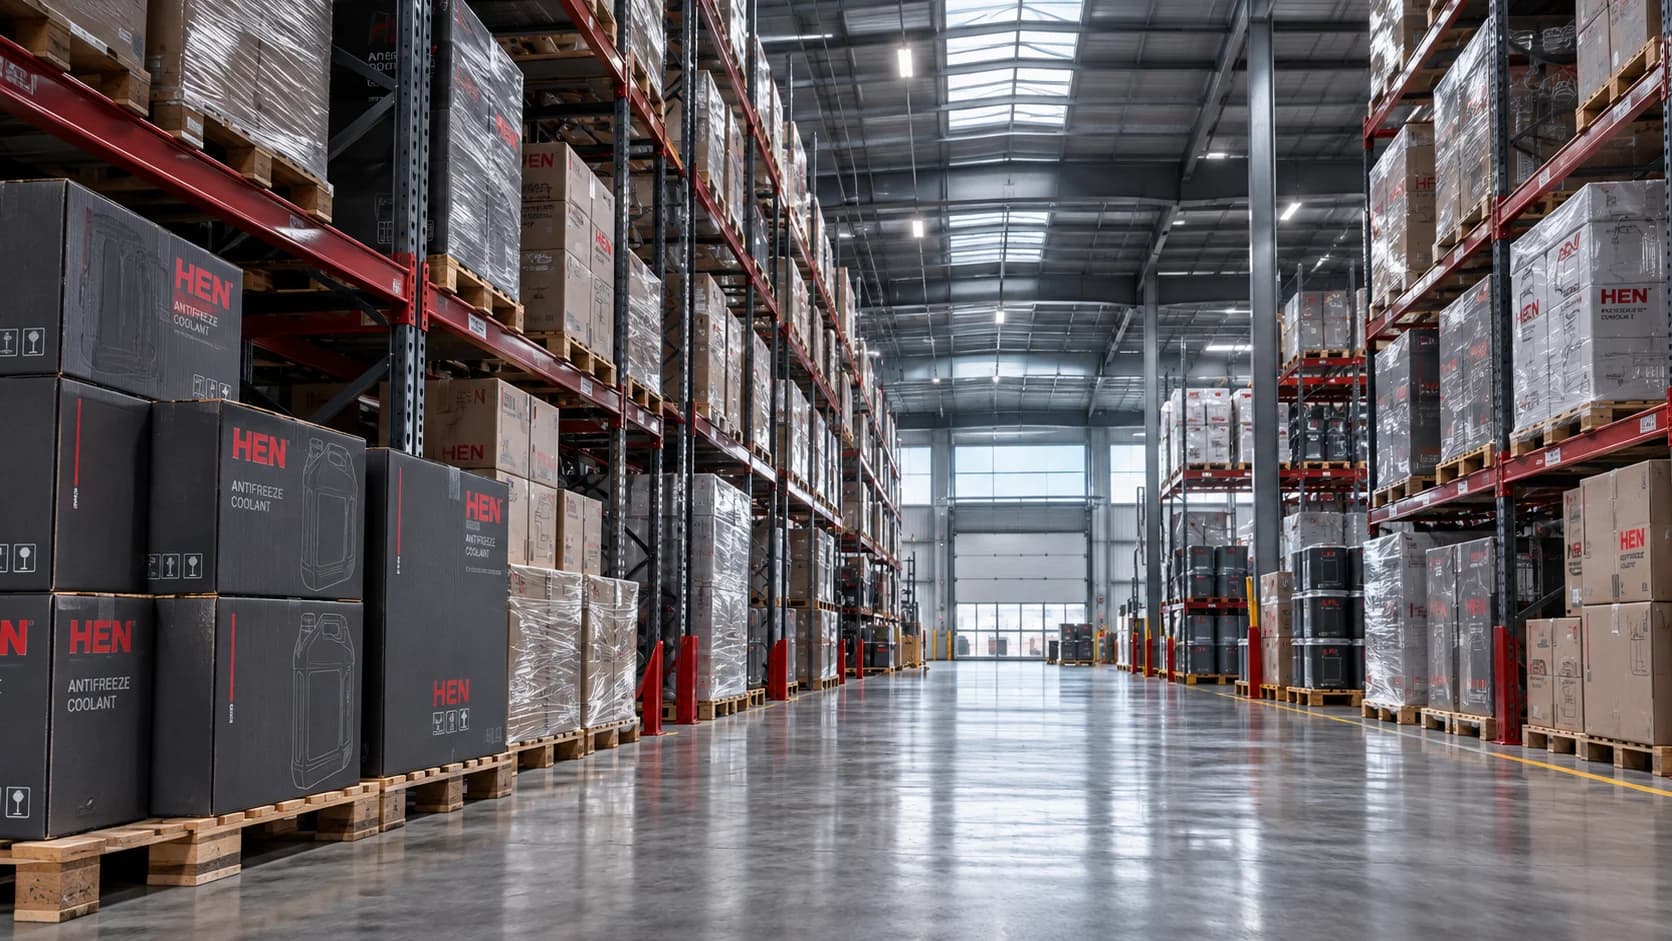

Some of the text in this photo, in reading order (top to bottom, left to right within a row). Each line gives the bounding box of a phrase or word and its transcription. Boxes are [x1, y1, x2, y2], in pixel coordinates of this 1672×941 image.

[175, 257, 231, 310] HEN
[1601, 287, 1648, 304] HEN
[173, 301, 219, 327] ANTIFREEZE
[173, 314, 210, 336] COOLANT
[1515, 299, 1539, 330] HEN
[232, 427, 287, 469] HEN
[442, 445, 485, 461] HEN
[231, 480, 284, 500] ANTIFREEZE
[231, 496, 271, 512] COOLANT
[466, 490, 502, 524] HEN
[1620, 528, 1645, 550] HEN
[69, 620, 132, 654] HEN
[67, 677, 131, 693] ANTIFREEZE
[432, 679, 470, 707] HEN
[67, 695, 117, 712] COOLANT
